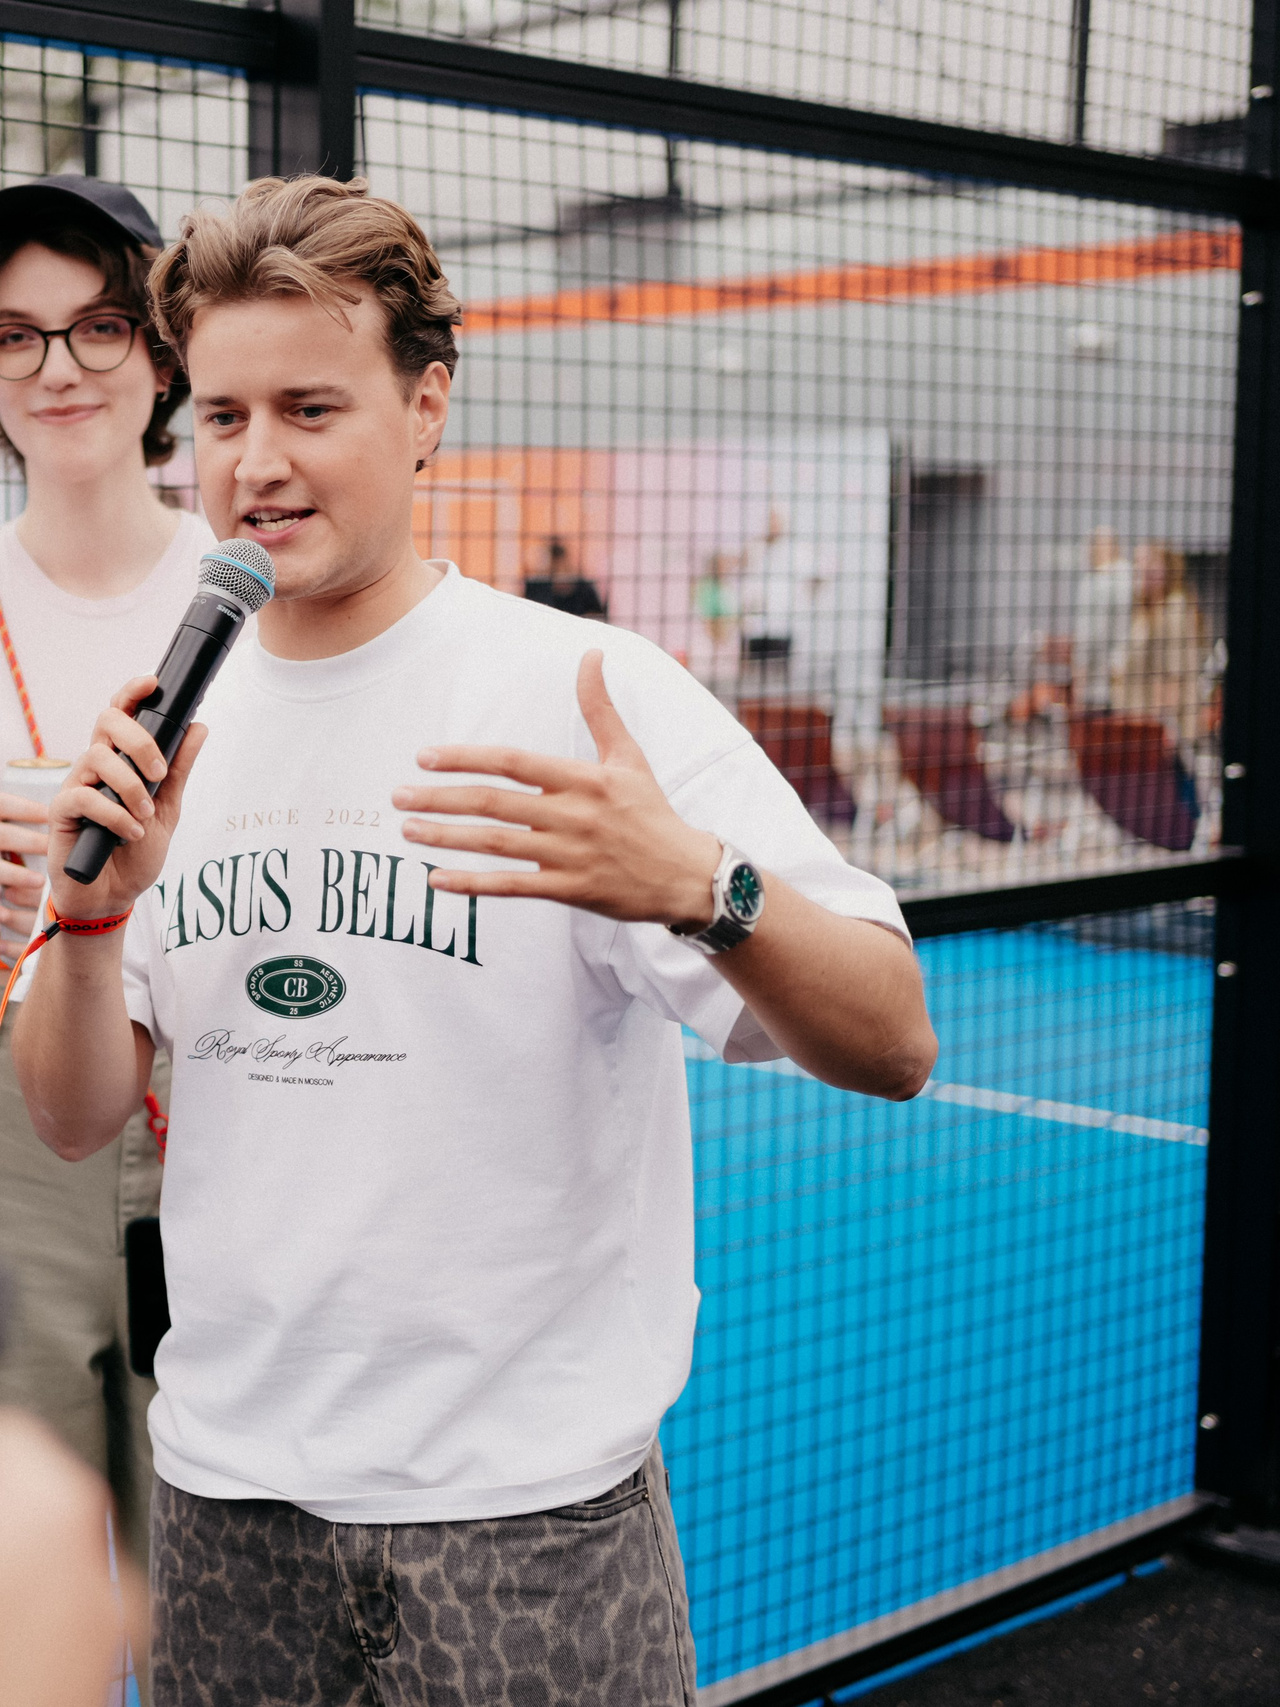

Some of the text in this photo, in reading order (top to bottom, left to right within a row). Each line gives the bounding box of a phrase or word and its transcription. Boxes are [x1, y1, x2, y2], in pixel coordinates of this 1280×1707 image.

[216, 604, 241, 622] SHURE
[225, 808, 380, 832] SINCE 2022
[316, 848, 484, 967] BELLI
[293, 959, 304, 968] SS
[249, 967, 265, 1001] SPORTS
[283, 976, 309, 998] CB
[319, 967, 339, 1009] AESTHETIC
[289, 1007, 299, 1015] 25
[187, 1028, 408, 1070] Royal Sporty Appearance
[247, 1072, 274, 1083] DESIGNED
[281, 1076, 297, 1085] MADE
[297, 1077, 304, 1085] IN
[304, 1078, 334, 1087] MOSCOW
